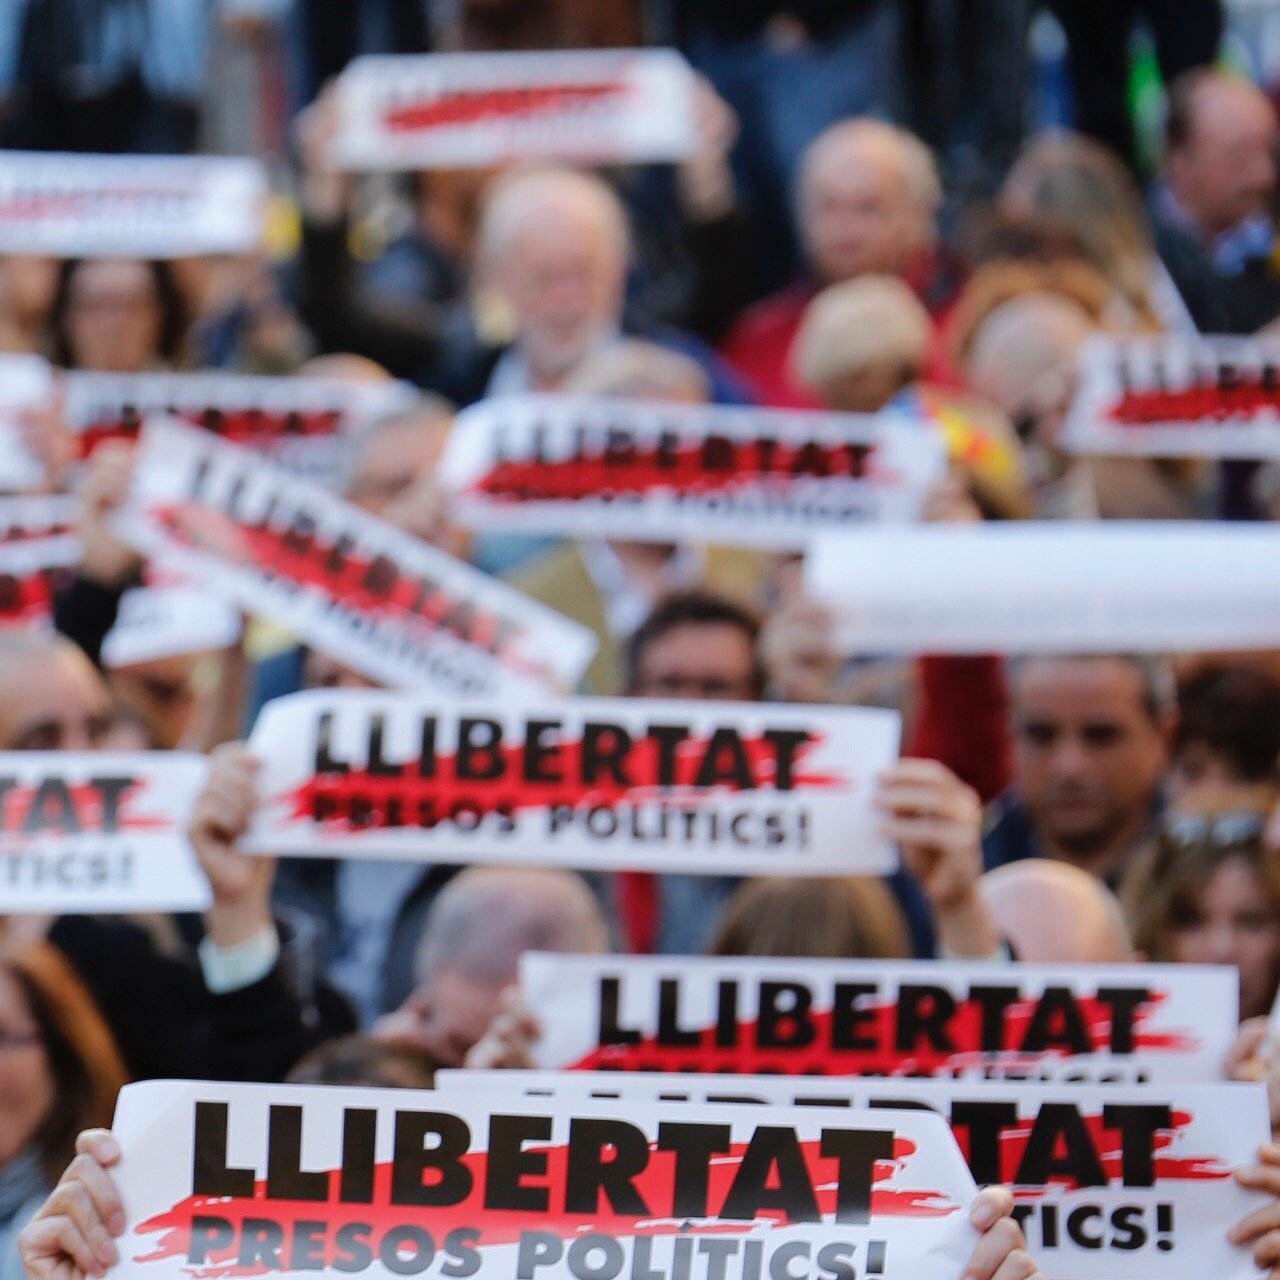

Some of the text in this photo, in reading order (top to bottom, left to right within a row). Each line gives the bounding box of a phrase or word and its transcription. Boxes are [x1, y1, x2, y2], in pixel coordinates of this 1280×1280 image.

[490, 424, 876, 478] LLIBERTAT
[314, 712, 814, 791] LLIBERTAT
[549, 798, 810, 848] POLÍTICS!
[598, 976, 1148, 1056] LLIBERTAT
[193, 1100, 896, 1228] LLIBERTAT
